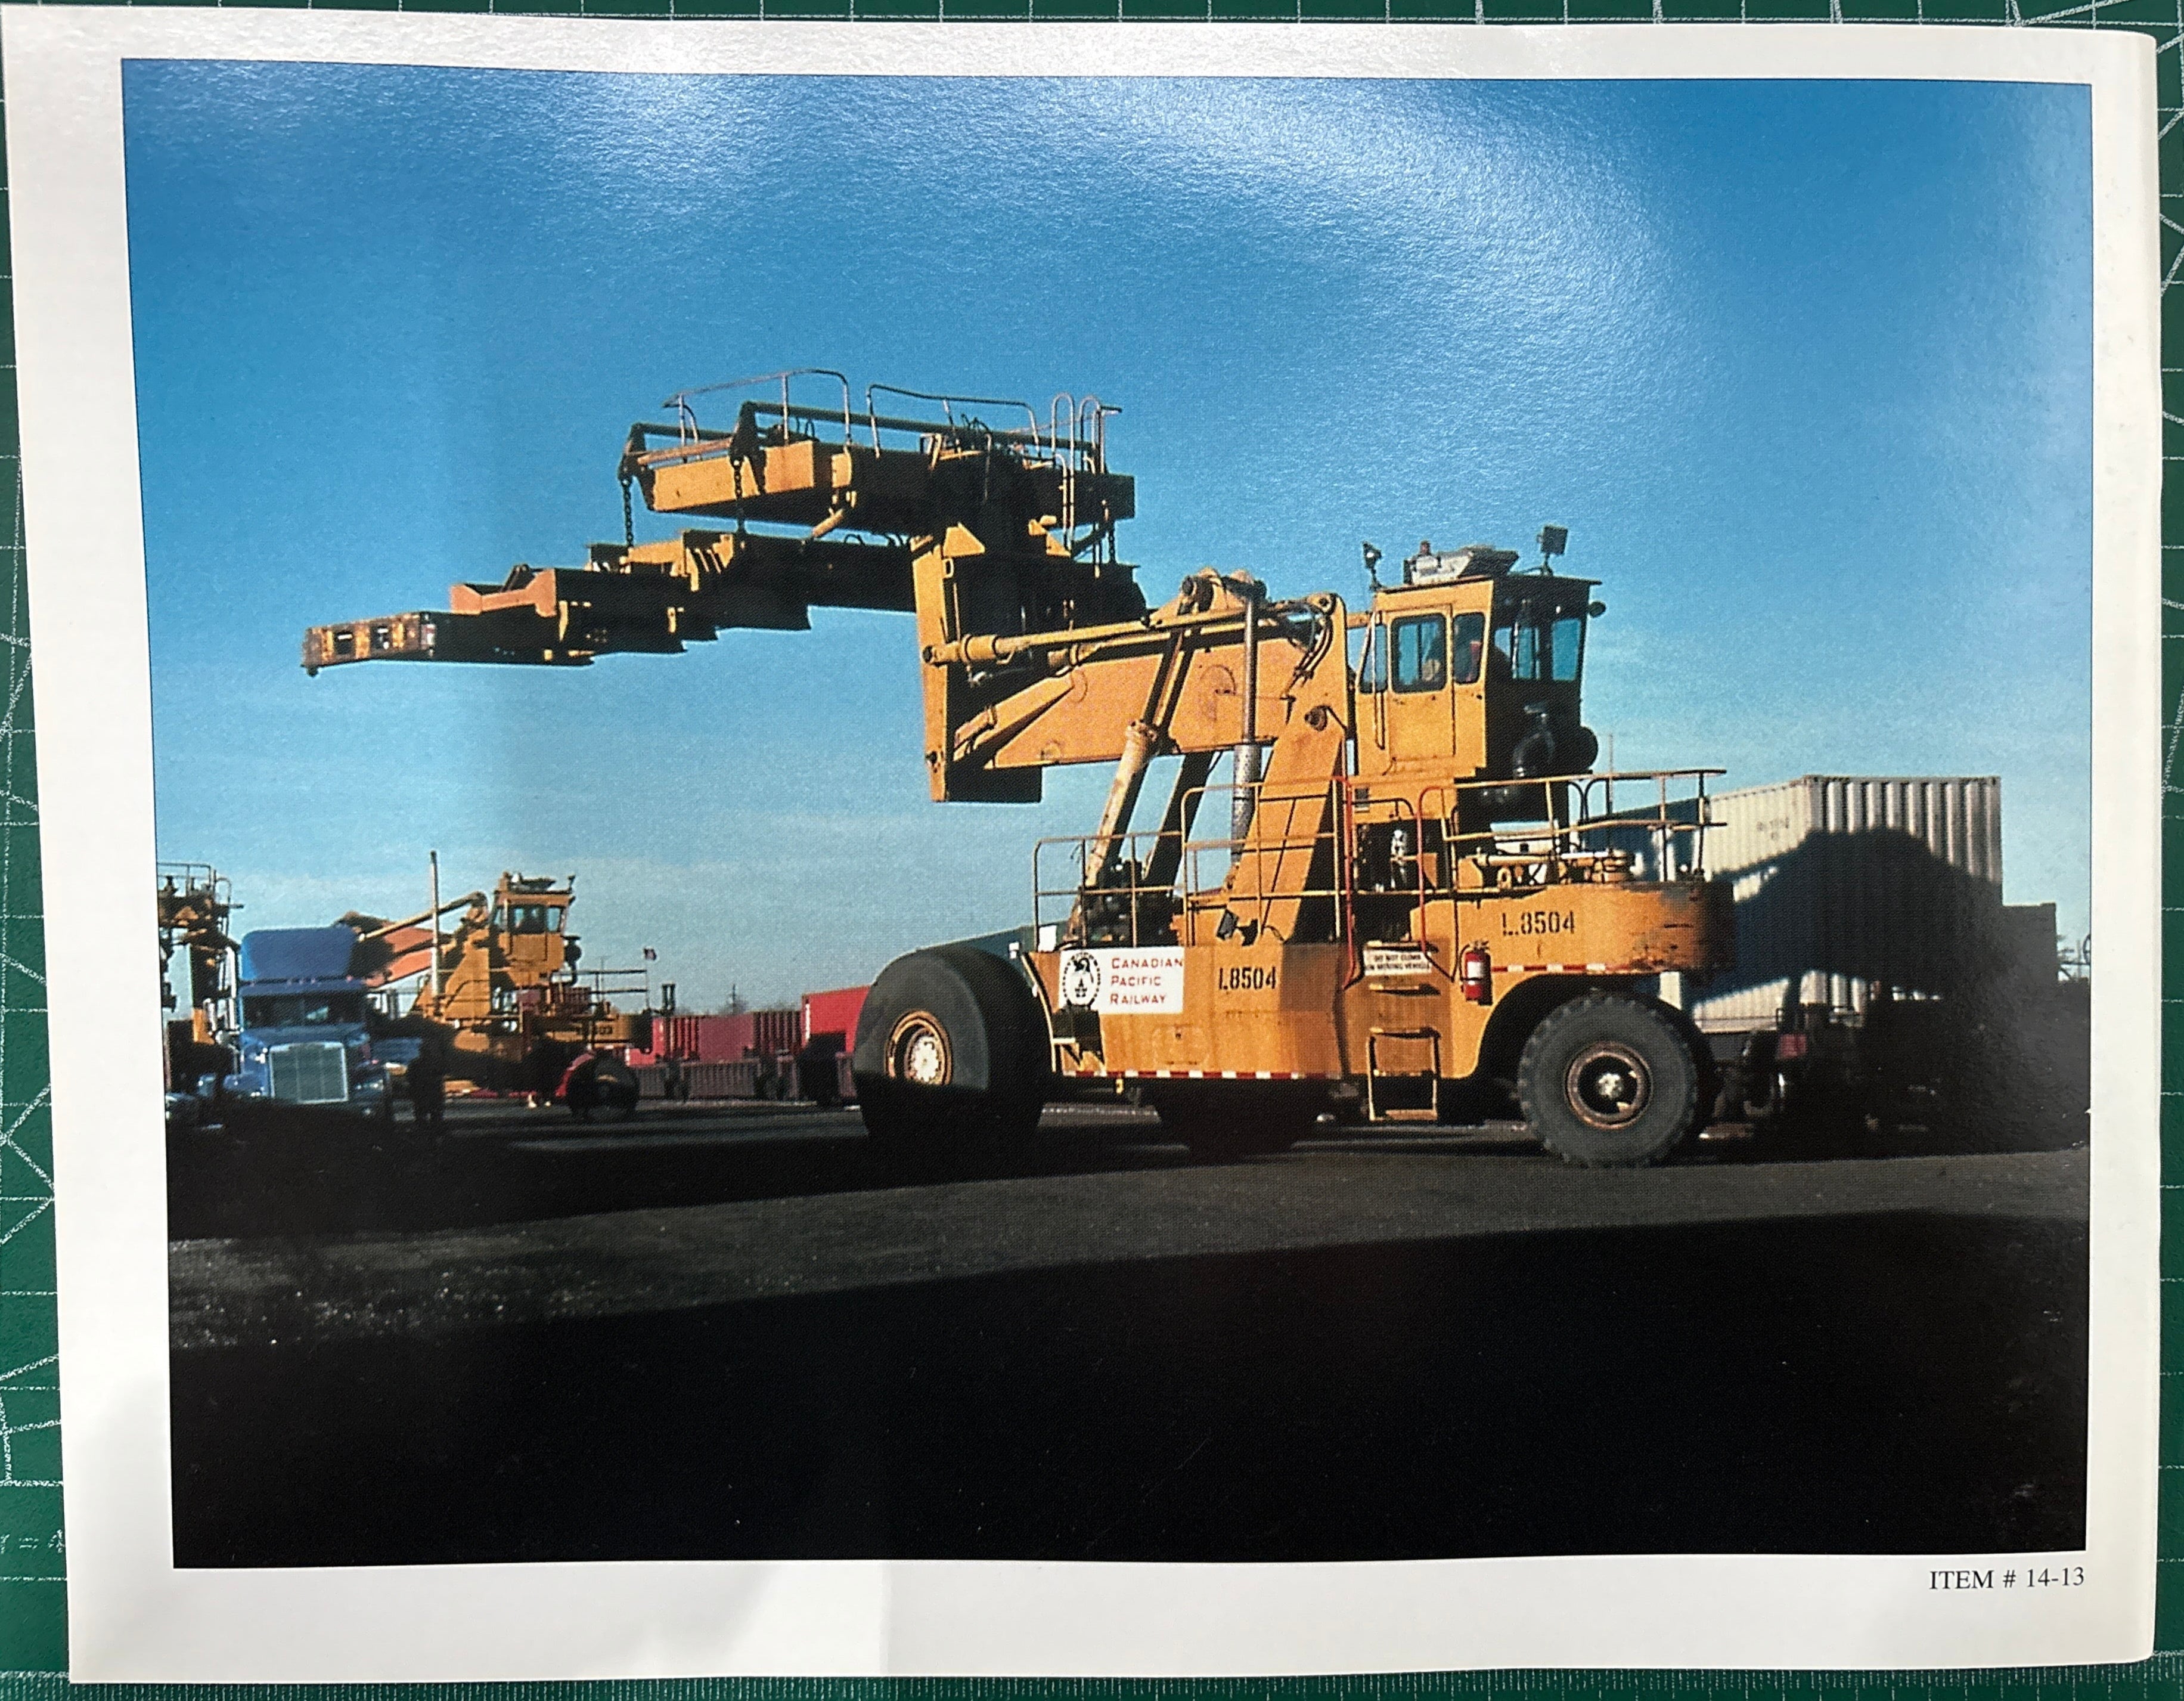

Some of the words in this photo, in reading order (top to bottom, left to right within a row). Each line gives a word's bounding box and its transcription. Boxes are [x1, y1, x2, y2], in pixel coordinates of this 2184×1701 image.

[1111, 958, 1183, 969] CANADIAN
[1111, 975, 1161, 986] PACIFIC
[1110, 993, 1166, 1005] RAILWAY
[1929, 1570, 1994, 1590] ITEM
[2003, 1569, 2017, 1588] #
[2027, 1566, 2084, 1587] 14-13
